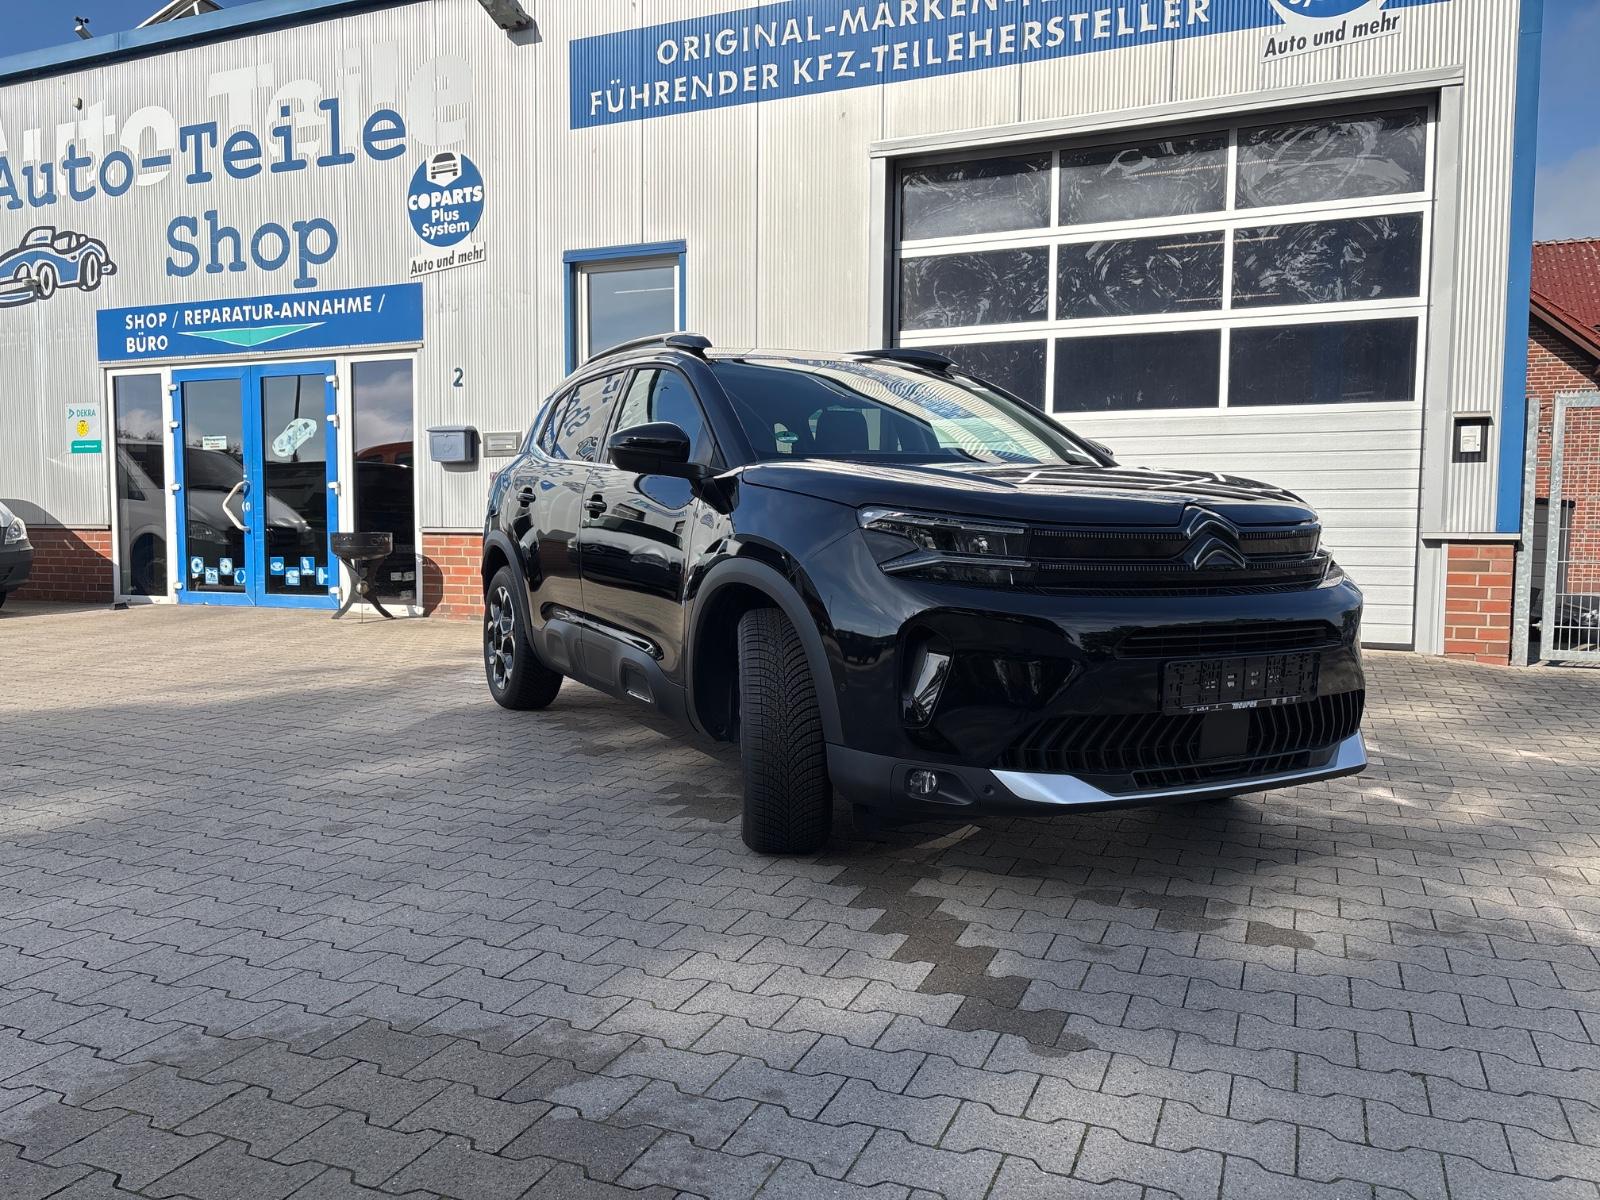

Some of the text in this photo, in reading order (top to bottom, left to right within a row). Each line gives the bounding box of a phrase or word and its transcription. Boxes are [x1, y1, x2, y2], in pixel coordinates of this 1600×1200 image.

[1264, 11, 1400, 57] Auto und mehr
[589, 0, 1210, 115] FÜHRENDER KFZ-TEILEHERSTELLER
[0, 97, 406, 210] Auto-Teile
[408, 185, 483, 211] COPARTS
[431, 208, 460, 223] Plus
[422, 221, 470, 240] System
[166, 210, 338, 288] Shop
[410, 245, 483, 275] Auto und mehr
[125, 294, 385, 330] SHOP / REPARATUR-ANNAHME /
[126, 332, 168, 353] BÜRO
[453, 367, 463, 387] 2
[77, 409, 96, 418] DEKRA
